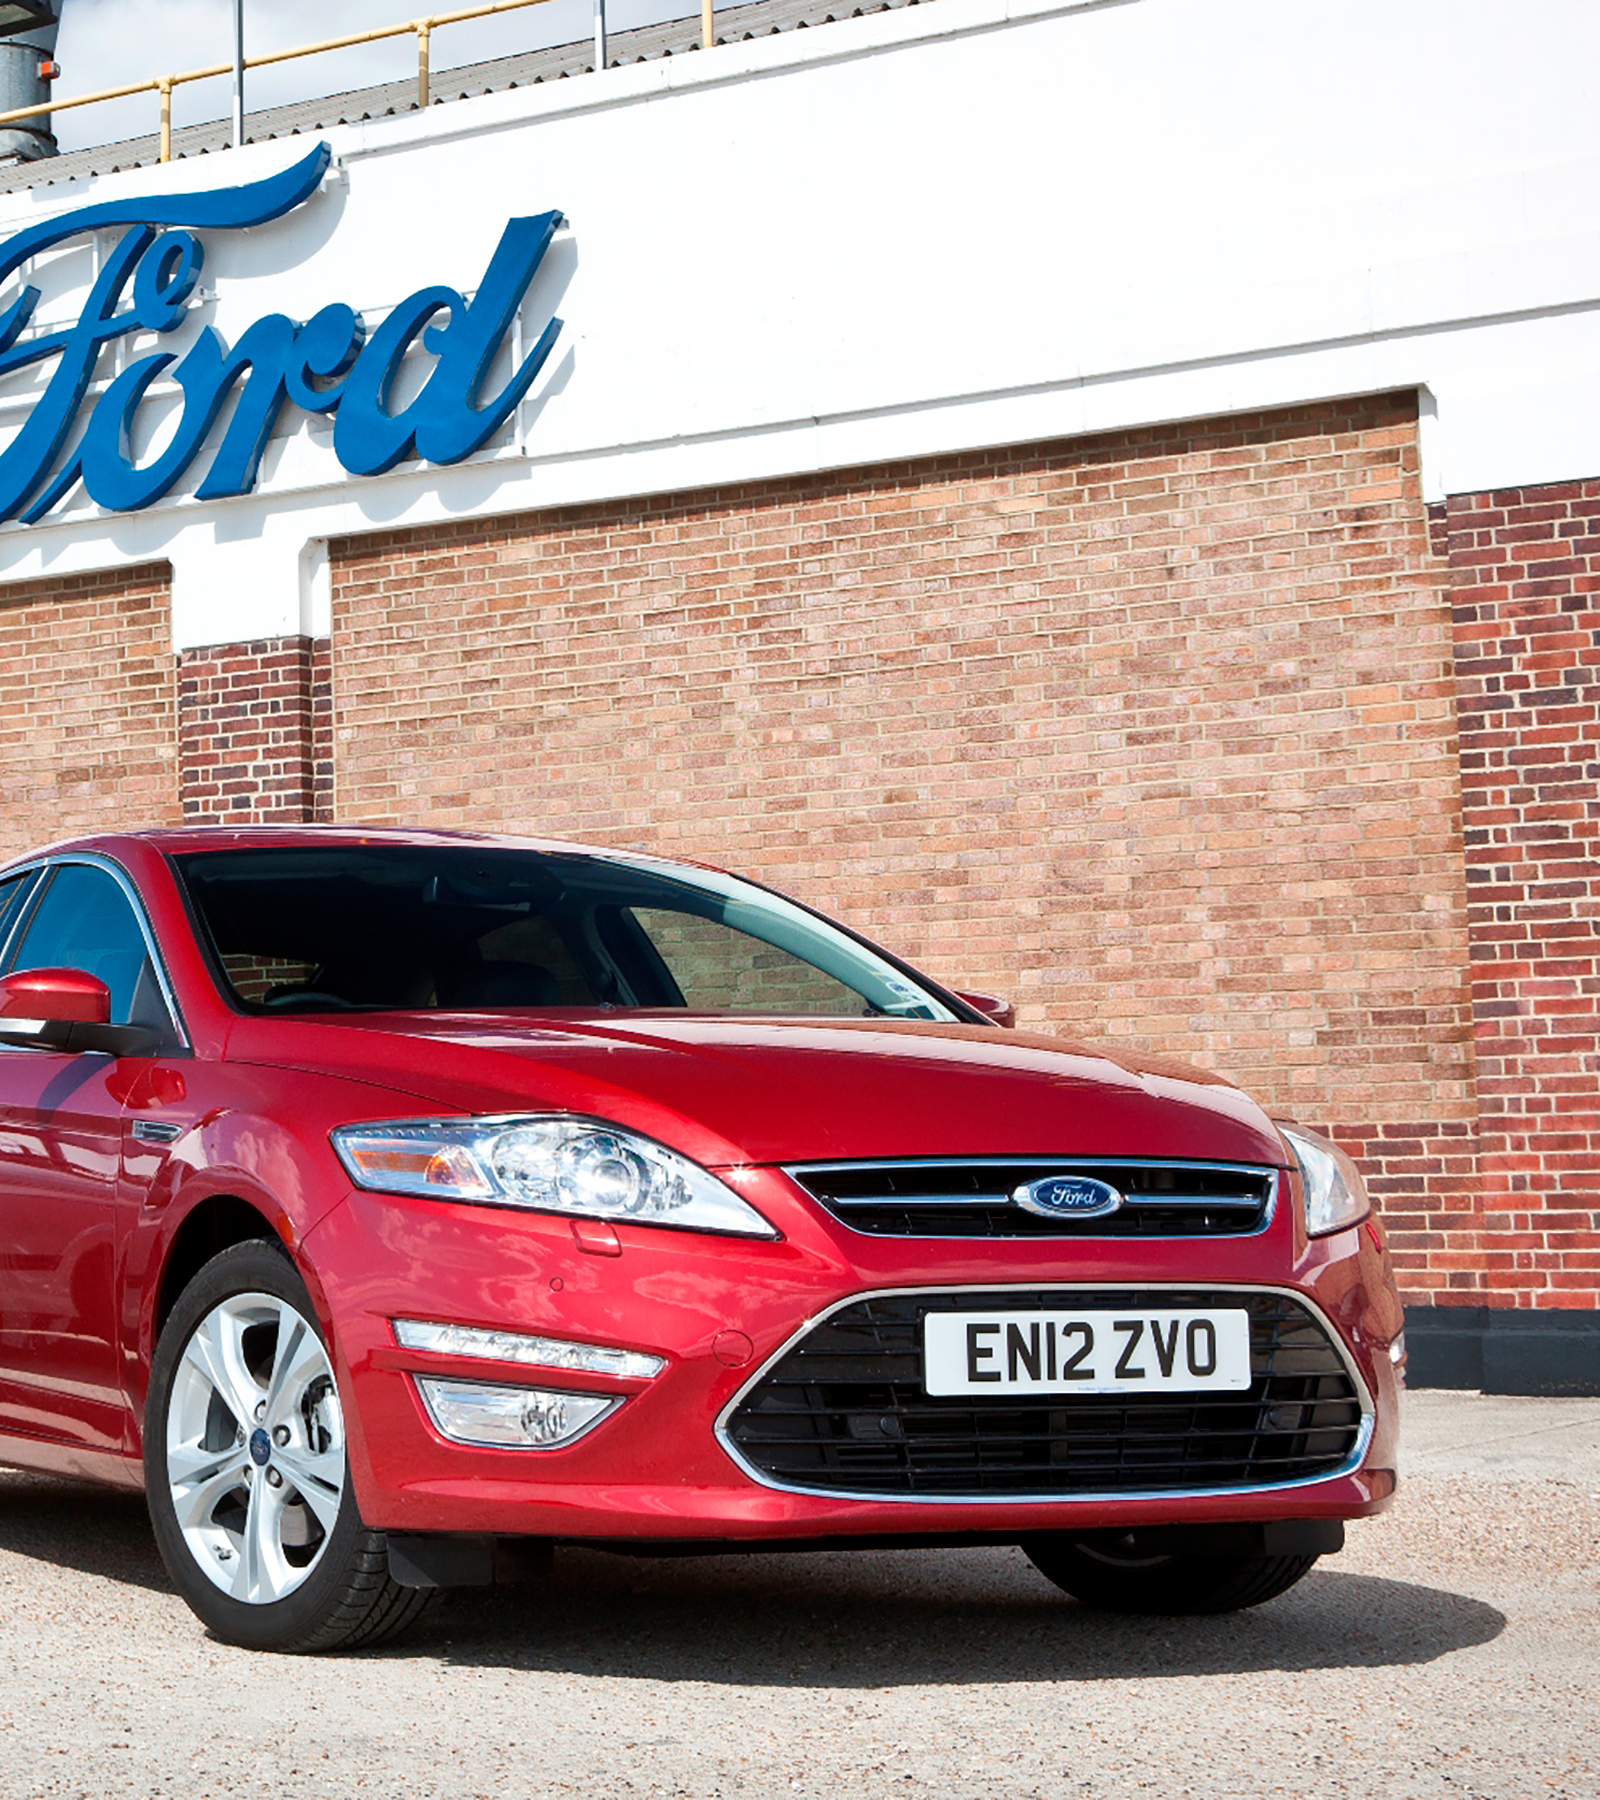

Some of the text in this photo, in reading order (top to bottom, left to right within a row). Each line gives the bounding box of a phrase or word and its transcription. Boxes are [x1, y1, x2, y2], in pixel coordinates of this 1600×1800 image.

[1051, 1184, 1097, 1205] Ford
[966, 1318, 1217, 1383] EN12 ZVO
